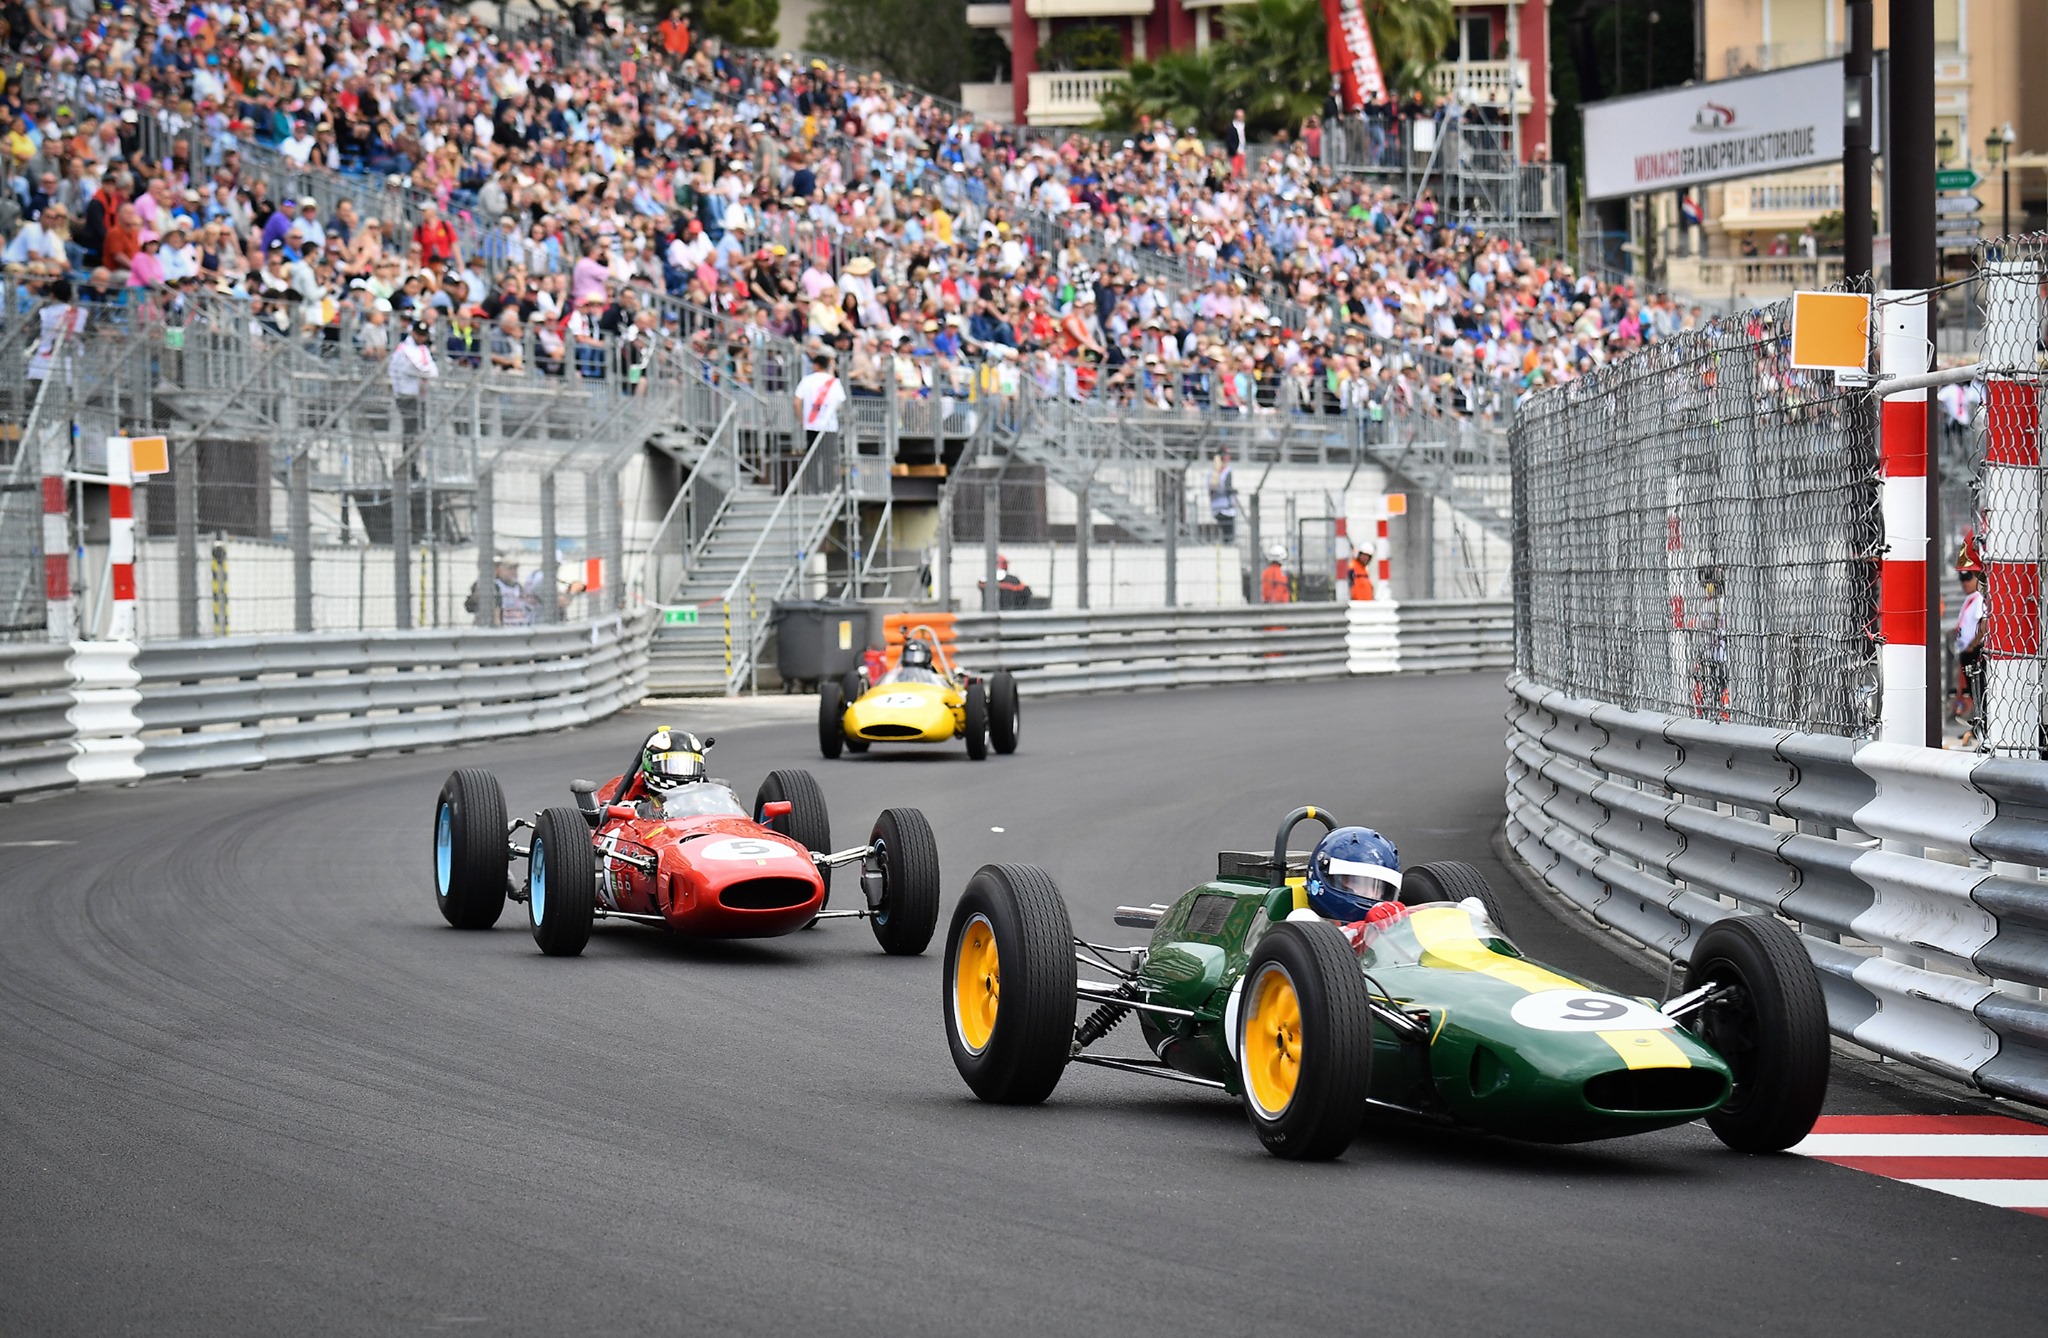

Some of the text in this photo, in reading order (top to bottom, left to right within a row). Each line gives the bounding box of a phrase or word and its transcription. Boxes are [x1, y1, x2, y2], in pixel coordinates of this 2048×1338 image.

[1634, 149, 1680, 182] MONACO
[730, 841, 770, 855] 5
[1560, 998, 1629, 1021] 9
